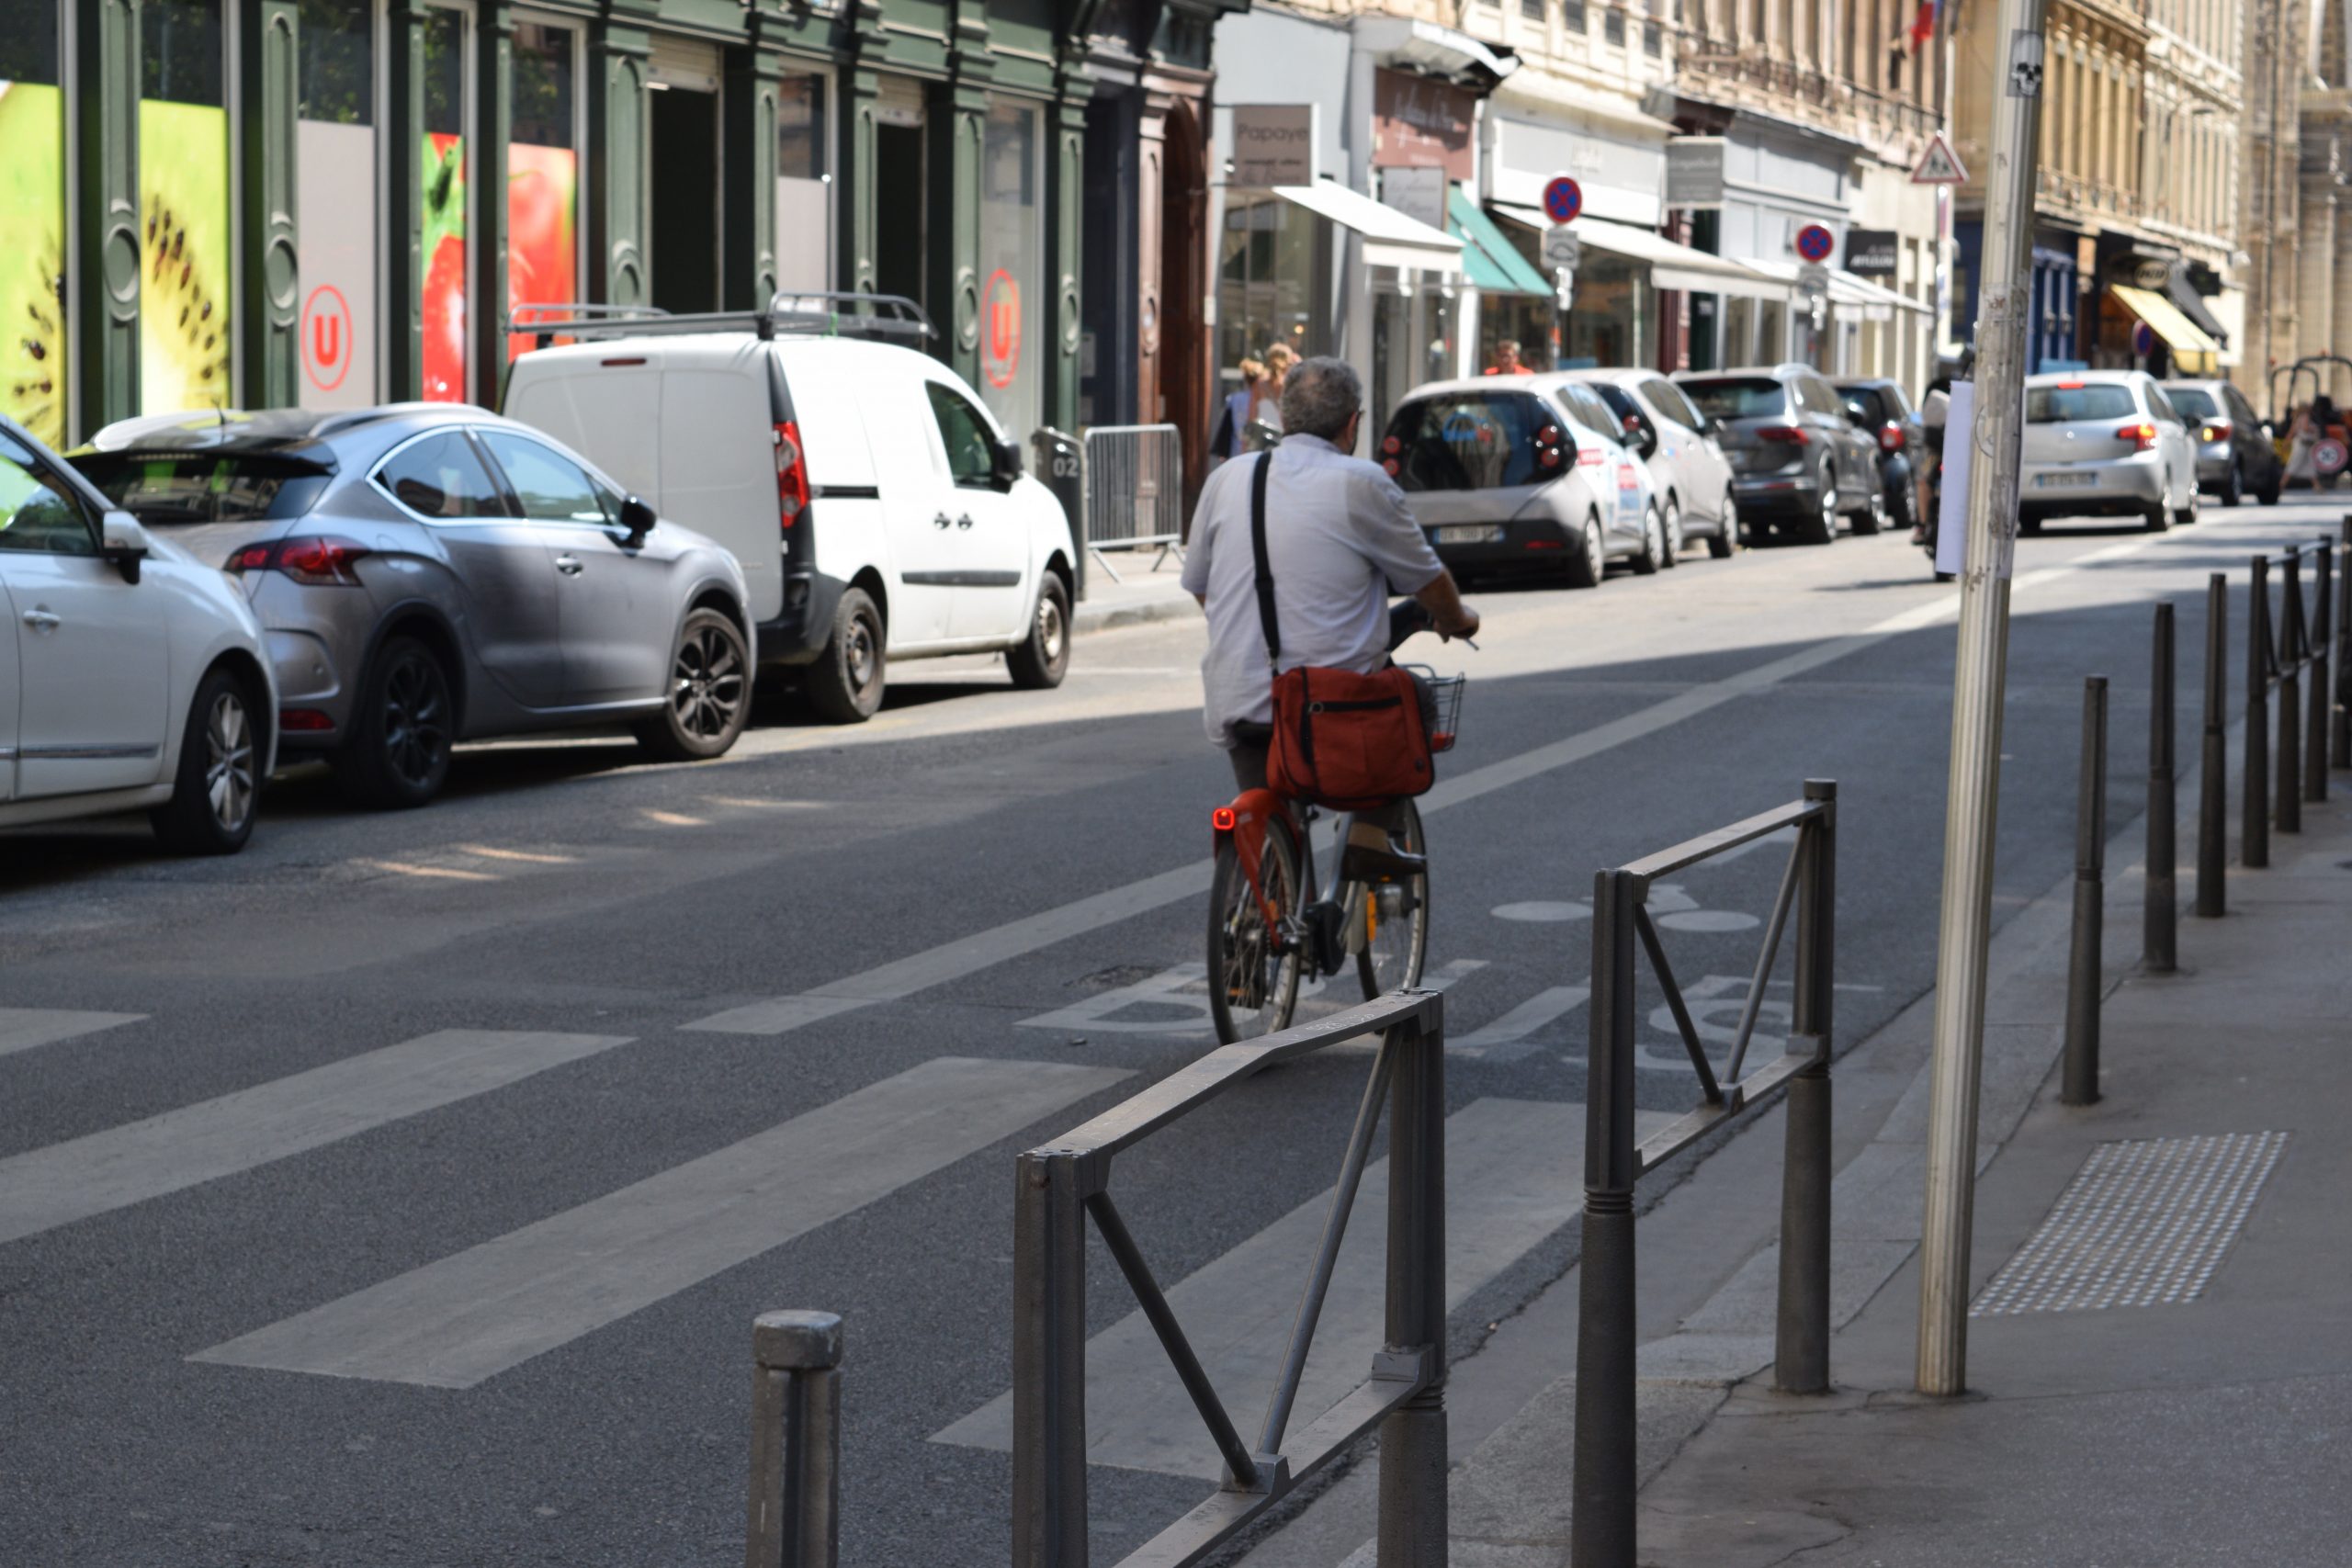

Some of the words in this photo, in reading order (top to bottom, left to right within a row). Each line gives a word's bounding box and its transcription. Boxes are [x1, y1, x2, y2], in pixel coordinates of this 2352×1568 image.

[1237, 123, 1308, 142] Papaye
[314, 314, 339, 367] U
[991, 301, 1011, 360] U
[1053, 457, 1079, 478] 02
